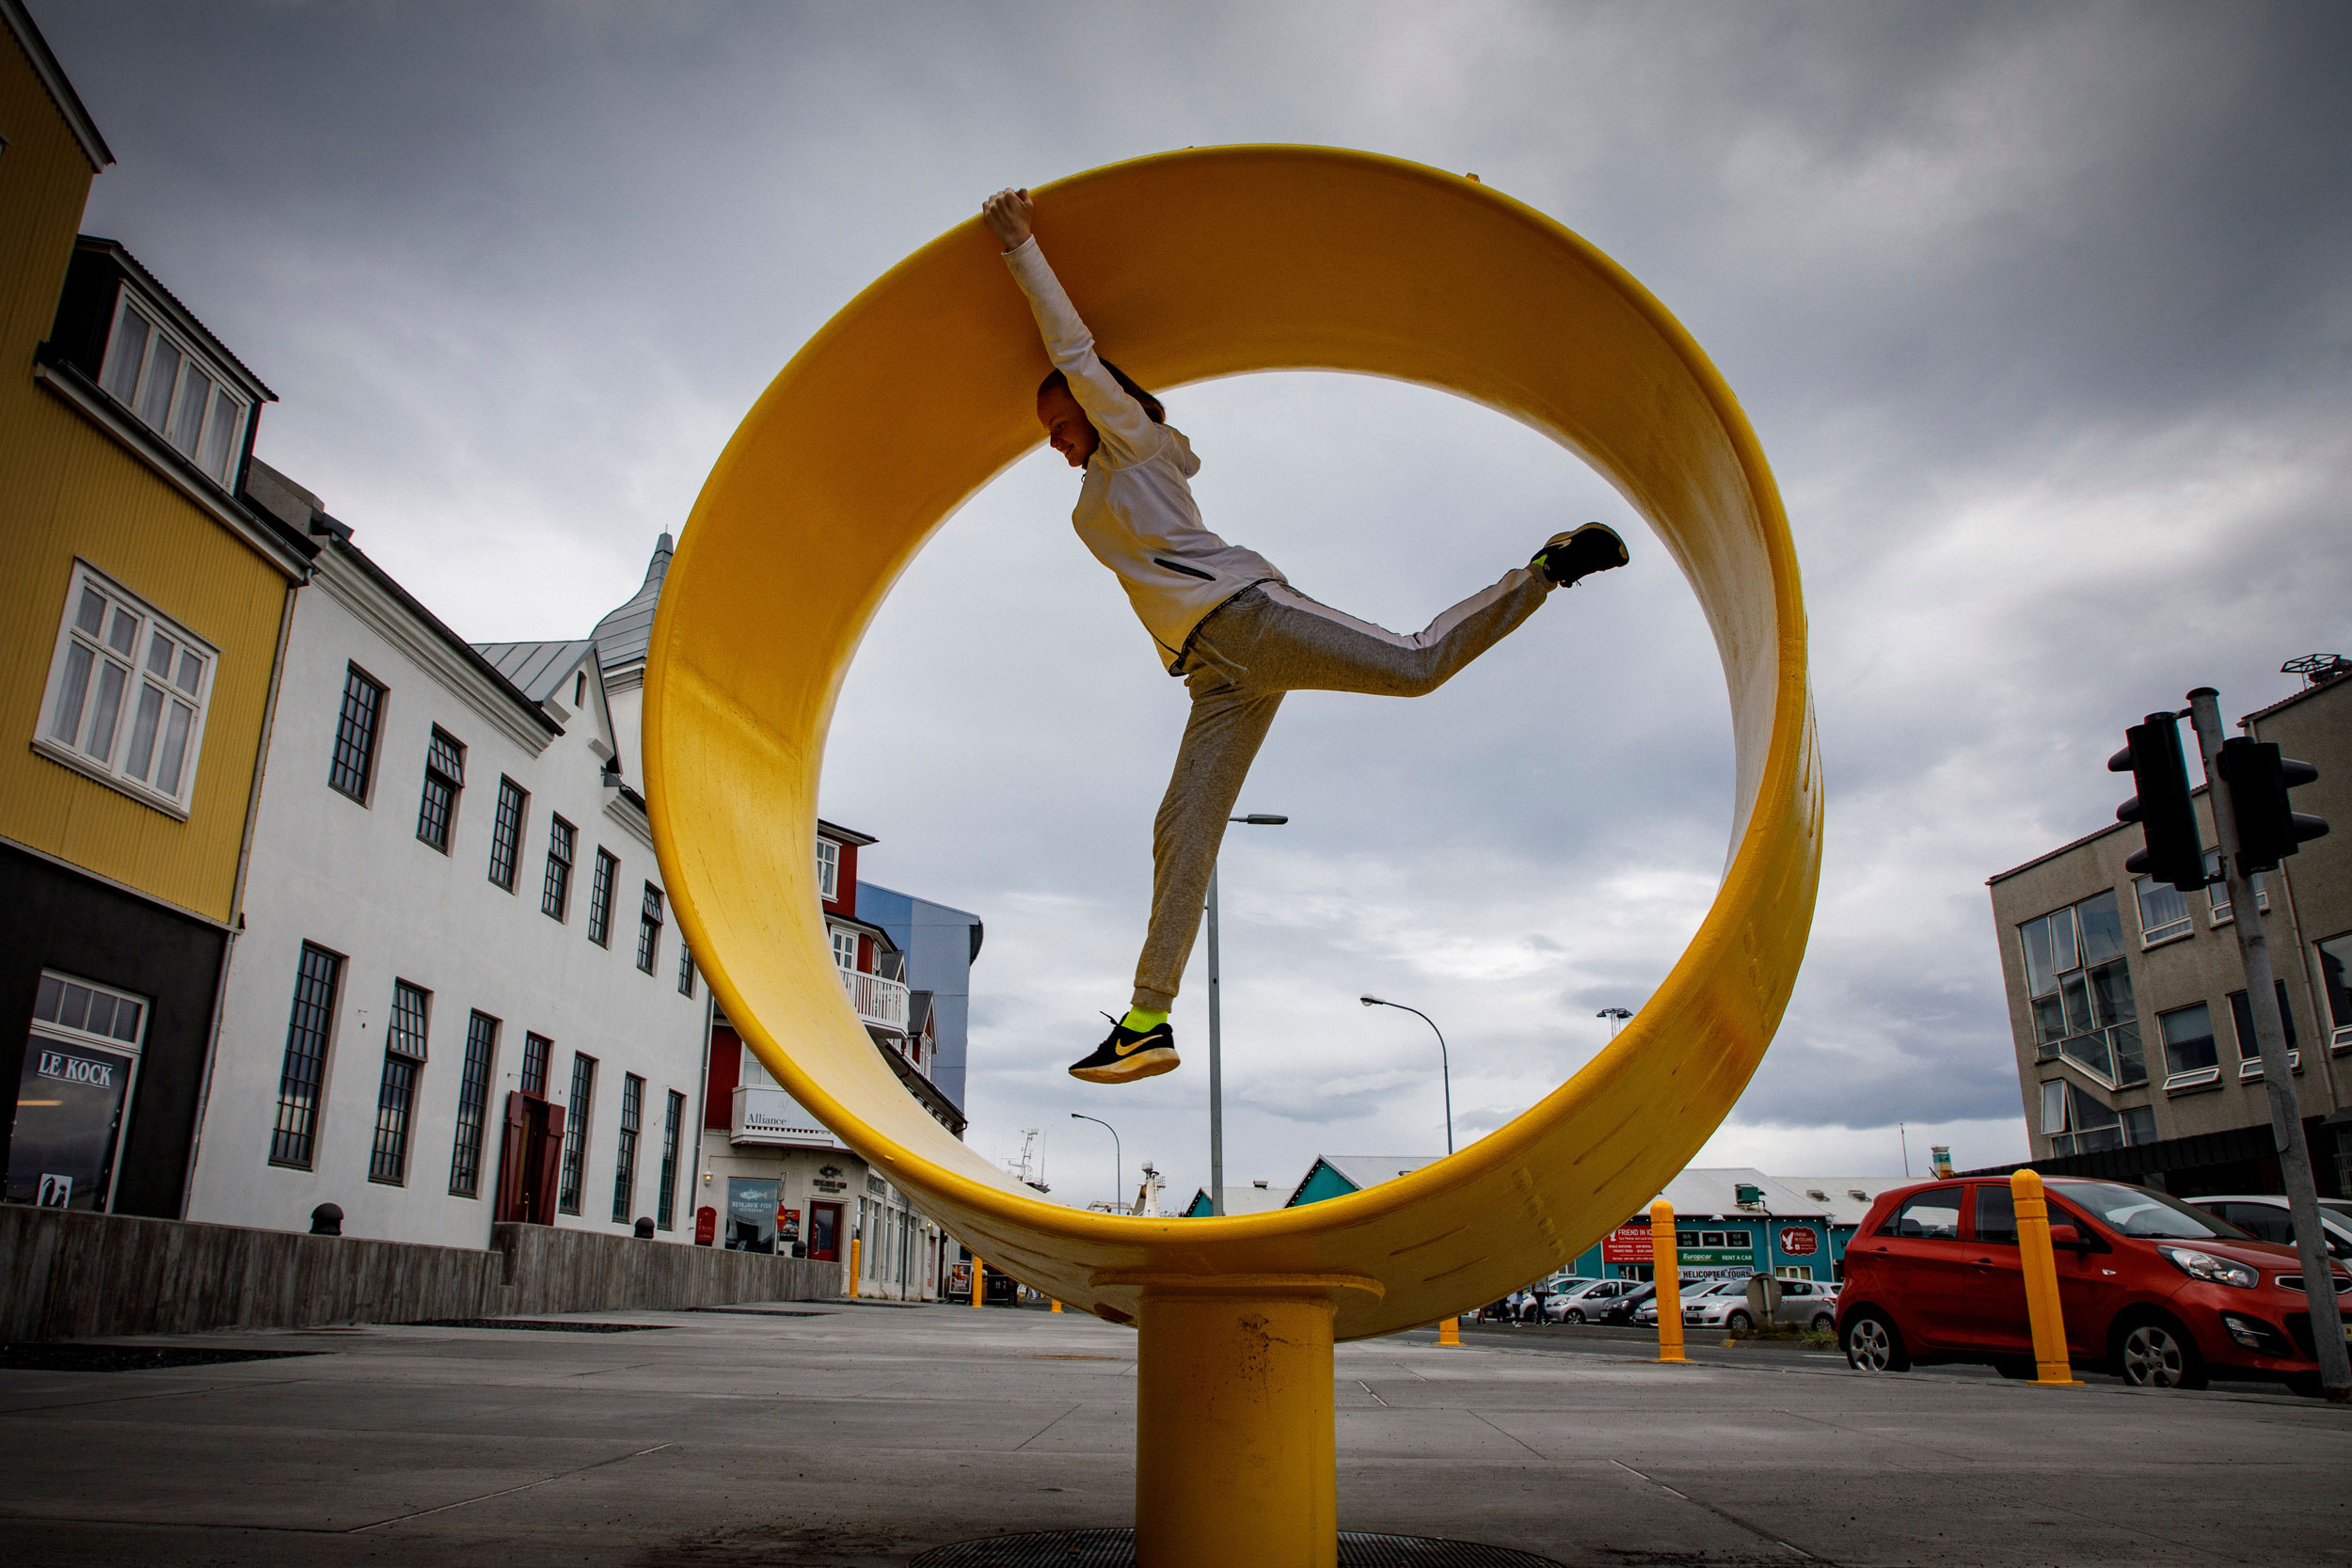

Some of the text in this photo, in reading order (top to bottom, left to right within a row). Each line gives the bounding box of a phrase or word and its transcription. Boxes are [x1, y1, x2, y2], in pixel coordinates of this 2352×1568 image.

[39, 1053, 113, 1086] LE KOCK
[746, 1113, 787, 1125] Alliance
[1683, 1253, 1712, 1261] Europcar
